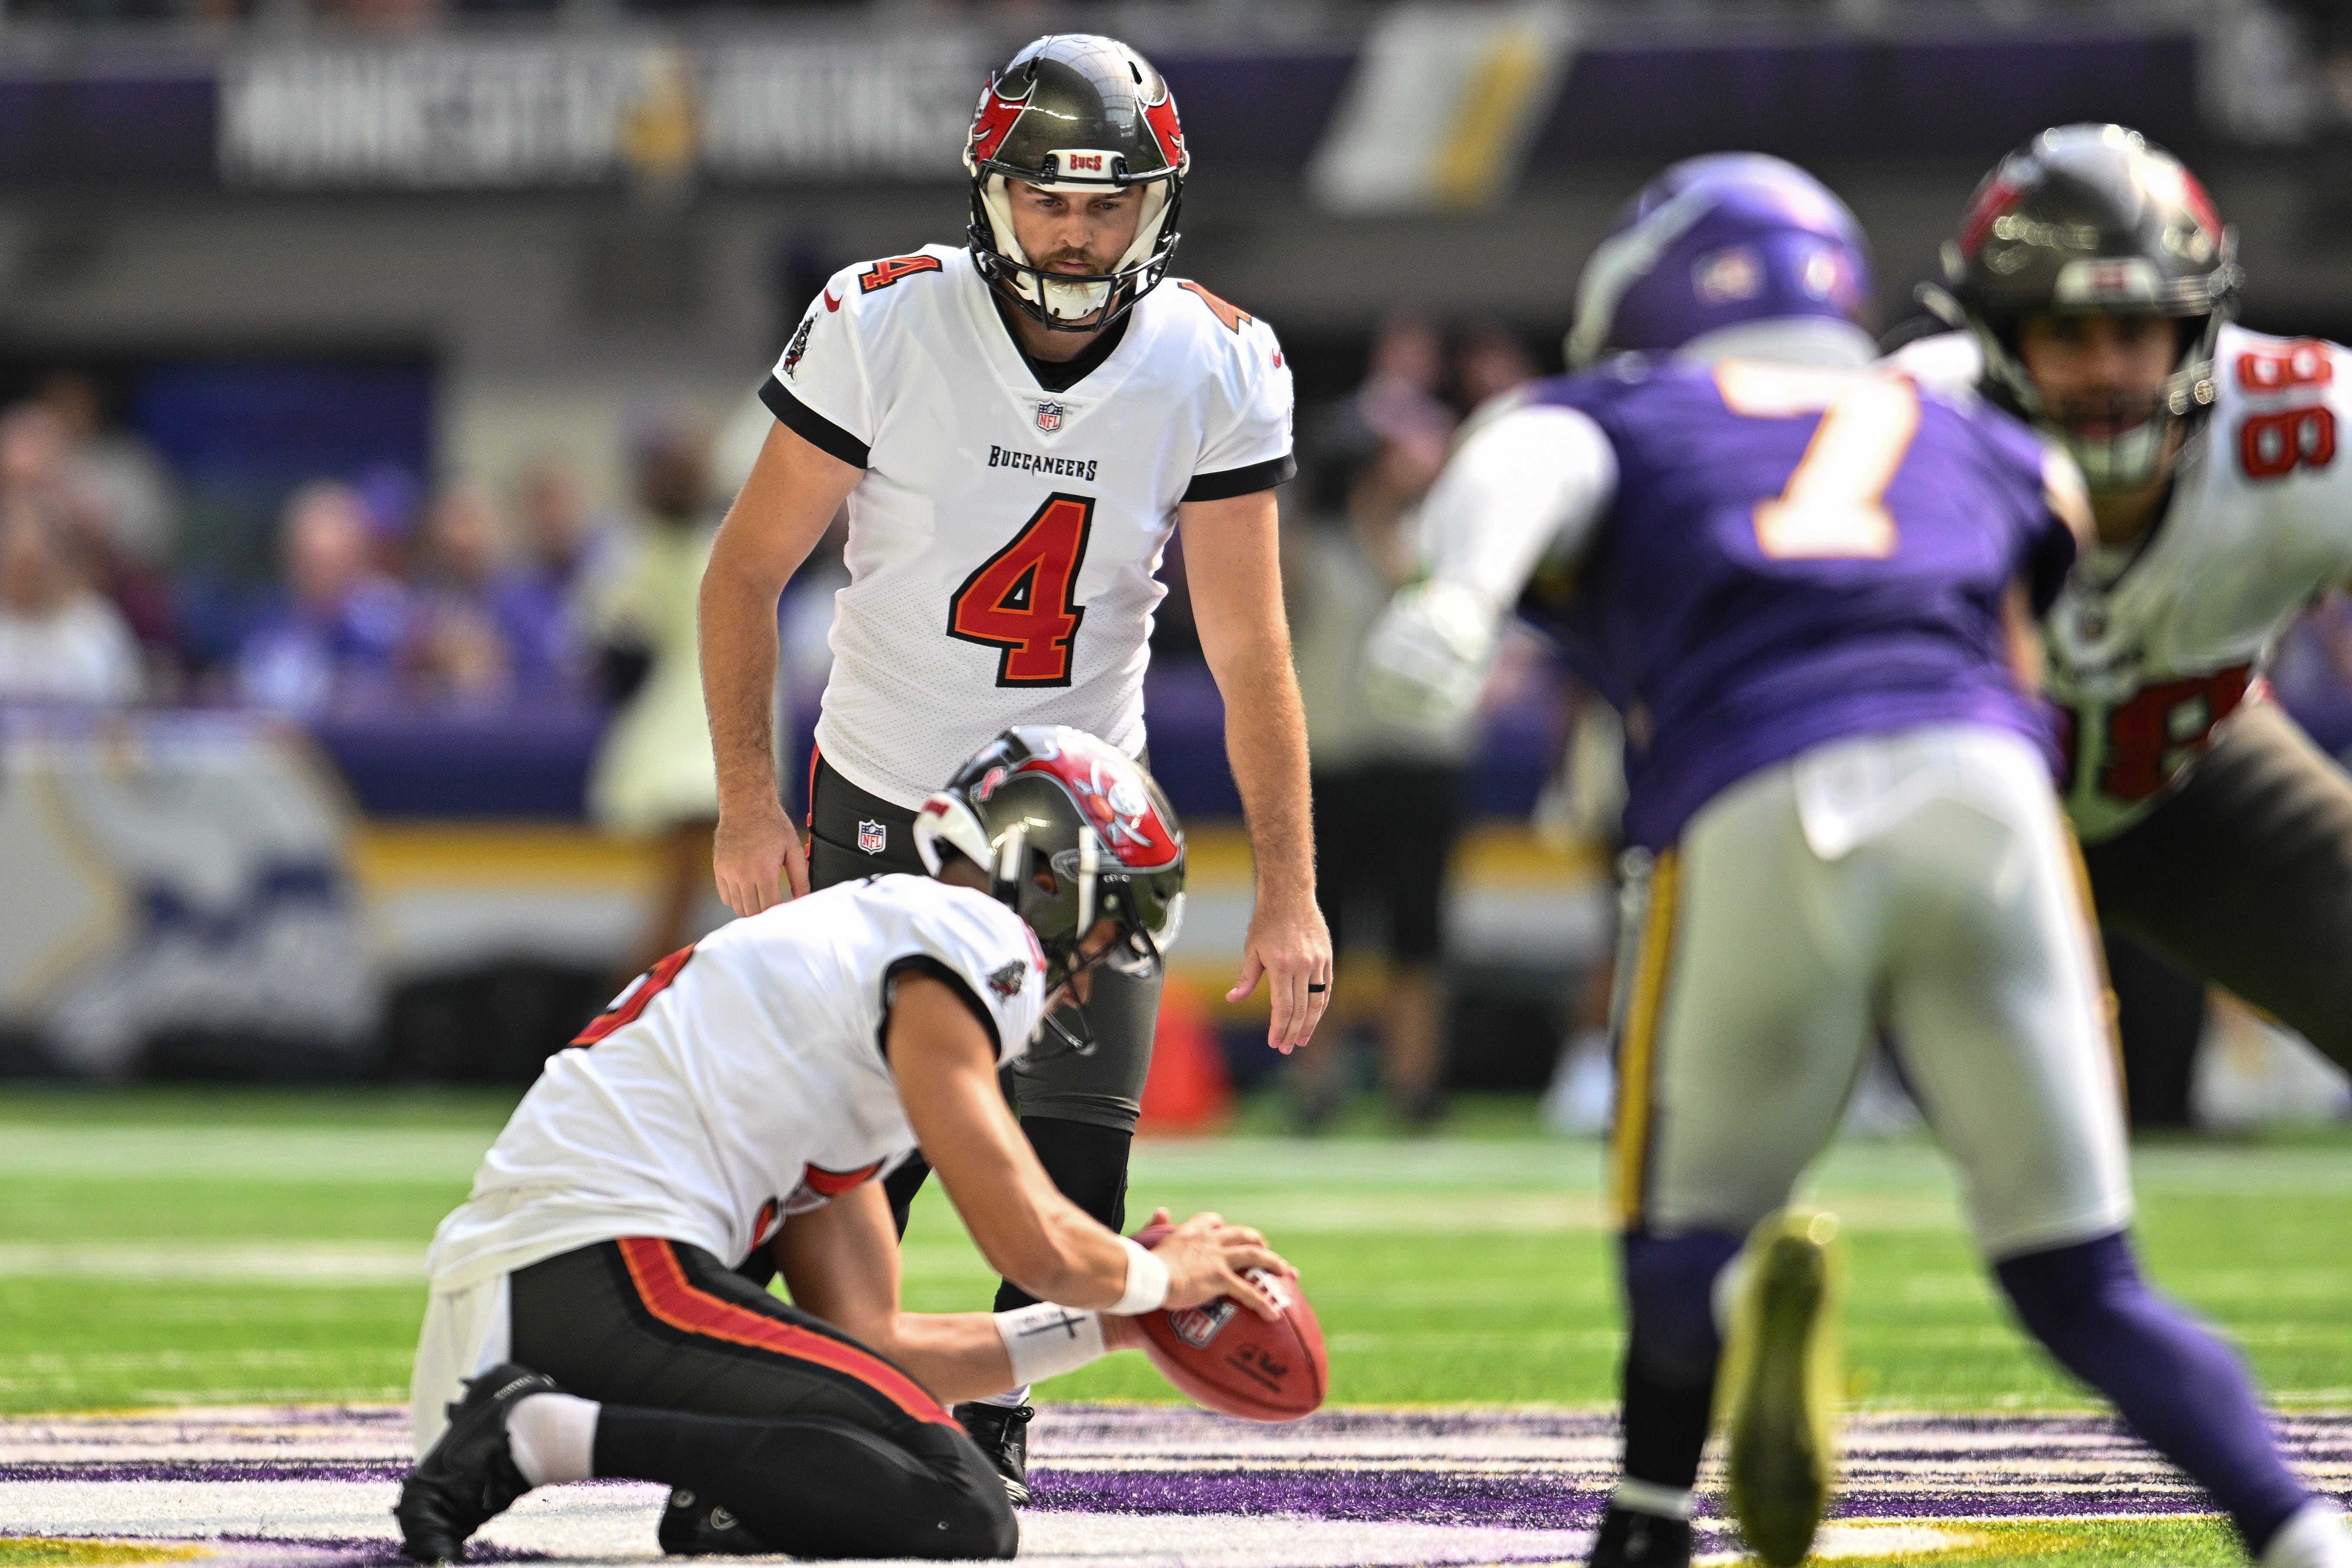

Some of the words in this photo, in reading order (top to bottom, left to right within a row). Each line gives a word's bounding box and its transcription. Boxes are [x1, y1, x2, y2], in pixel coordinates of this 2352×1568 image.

[1069, 154, 1103, 171] BUCS
[858, 254, 943, 295] 4
[1038, 413, 1061, 429] NFL
[987, 445, 1098, 482] BUCCANEERS
[1711, 355, 1923, 561] 7
[946, 491, 1096, 688] 4
[862, 834, 881, 849] NFL
